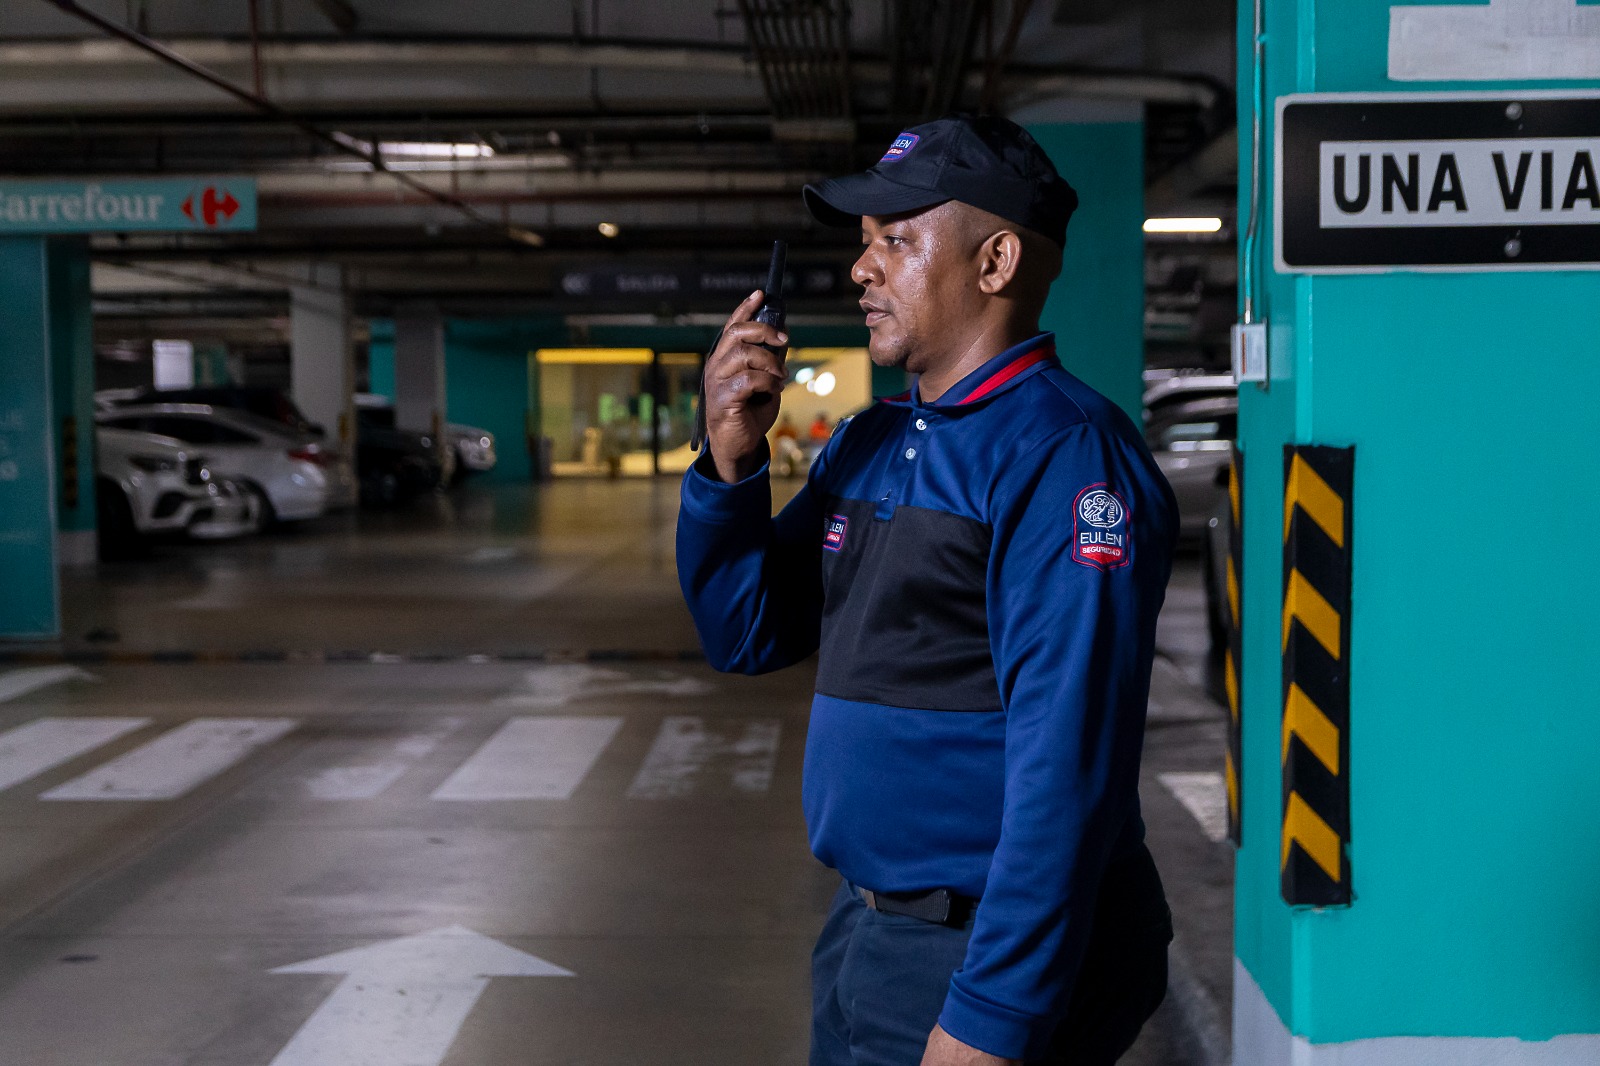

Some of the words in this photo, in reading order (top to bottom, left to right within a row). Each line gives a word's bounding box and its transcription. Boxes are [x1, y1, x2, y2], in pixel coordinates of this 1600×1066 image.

[1333, 151, 1469, 215] UNA
[1491, 149, 1600, 213] VIA
[0, 183, 164, 221] arrefour
[1080, 531, 1122, 546] EULEN
[1081, 546, 1122, 557] SEGURIDAD
